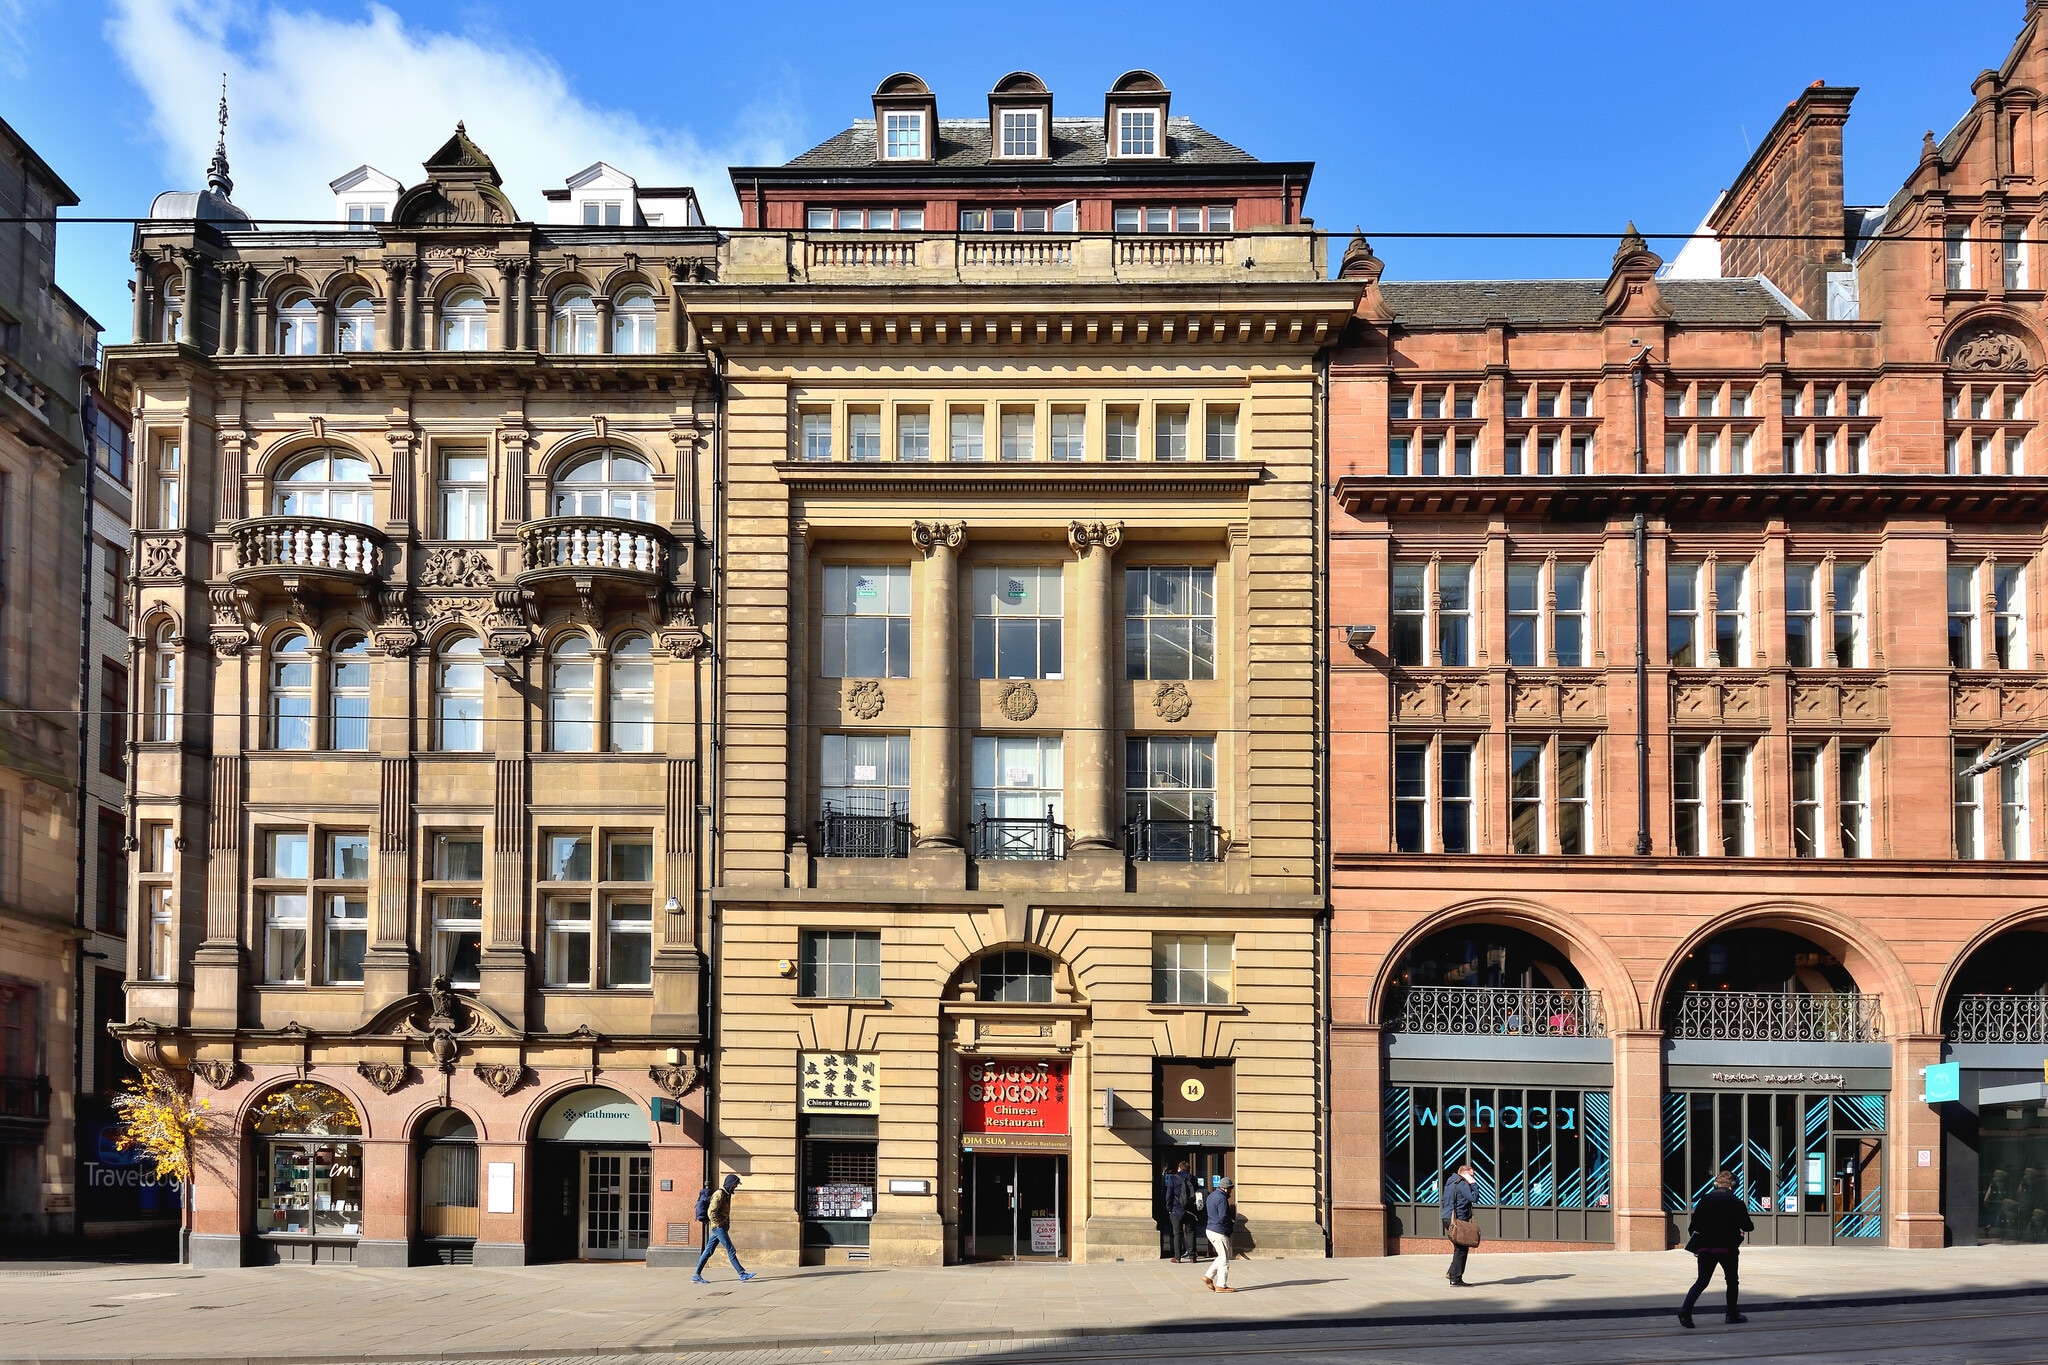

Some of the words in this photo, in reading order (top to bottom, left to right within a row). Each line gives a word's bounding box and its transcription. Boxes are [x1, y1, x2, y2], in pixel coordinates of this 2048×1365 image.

[969, 1065, 1048, 1082] SAIGON
[969, 1085, 1048, 1102] SAIGON
[1187, 1086, 1198, 1095] 14
[578, 1109, 630, 1119] strathmore
[994, 1105, 1037, 1115] Chinese
[1415, 1099, 1575, 1130] wahaca
[986, 1118, 1044, 1127] Restaurant
[1168, 1128, 1189, 1136] YORK
[985, 1137, 1006, 1145] SUM
